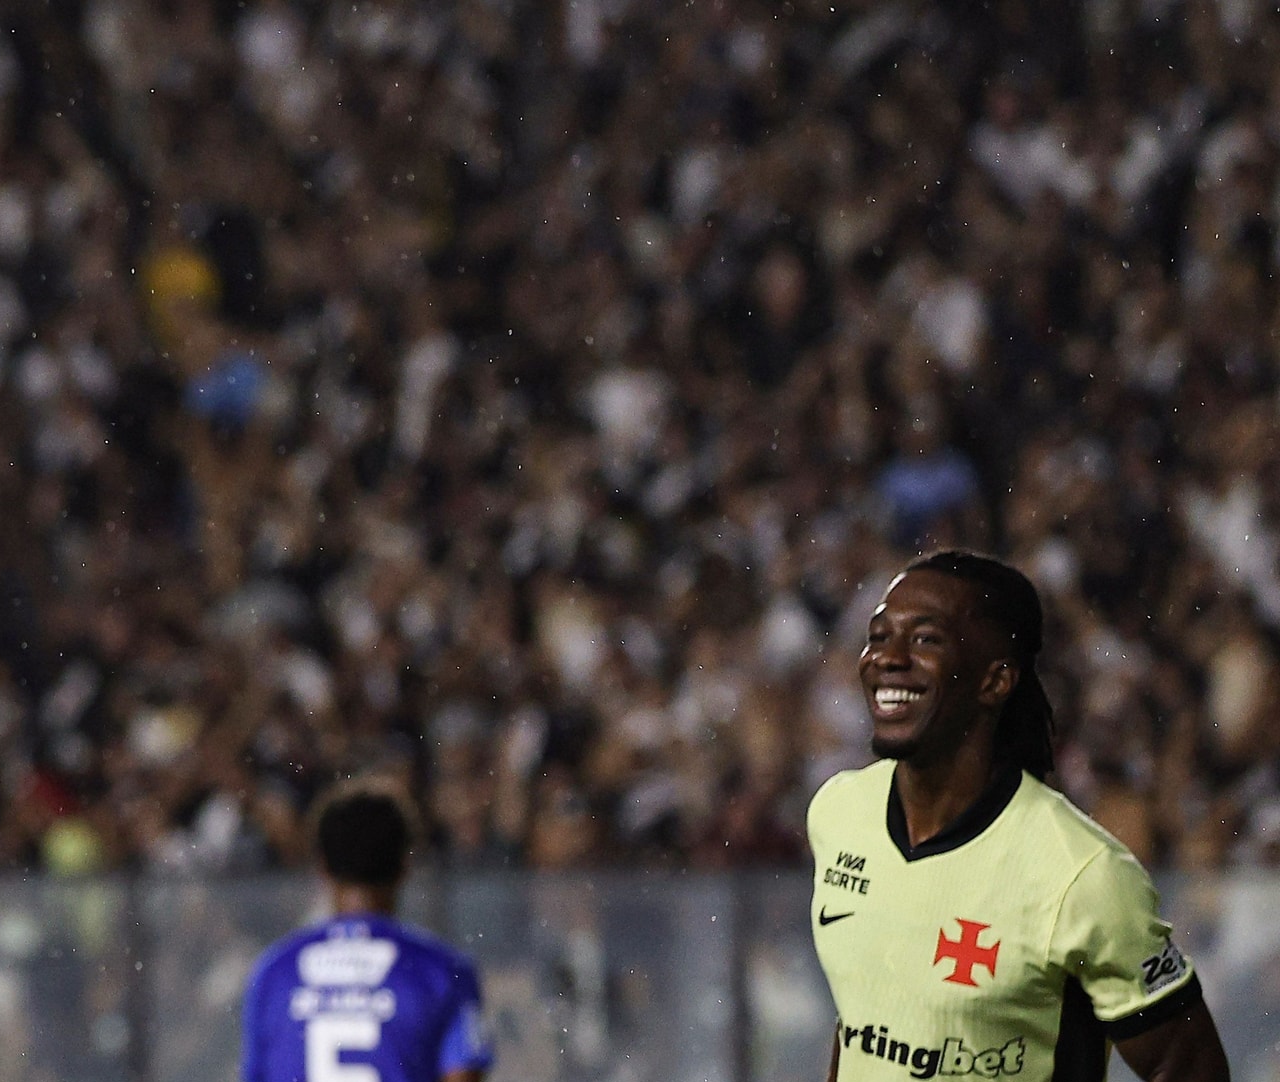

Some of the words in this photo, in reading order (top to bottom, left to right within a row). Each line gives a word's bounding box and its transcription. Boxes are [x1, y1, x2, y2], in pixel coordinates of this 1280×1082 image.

[836, 851, 866, 871] VIVA
[824, 868, 870, 894] SORTE
[1142, 949, 1178, 984] Zé
[839, 1021, 1025, 1080] rtingbet
